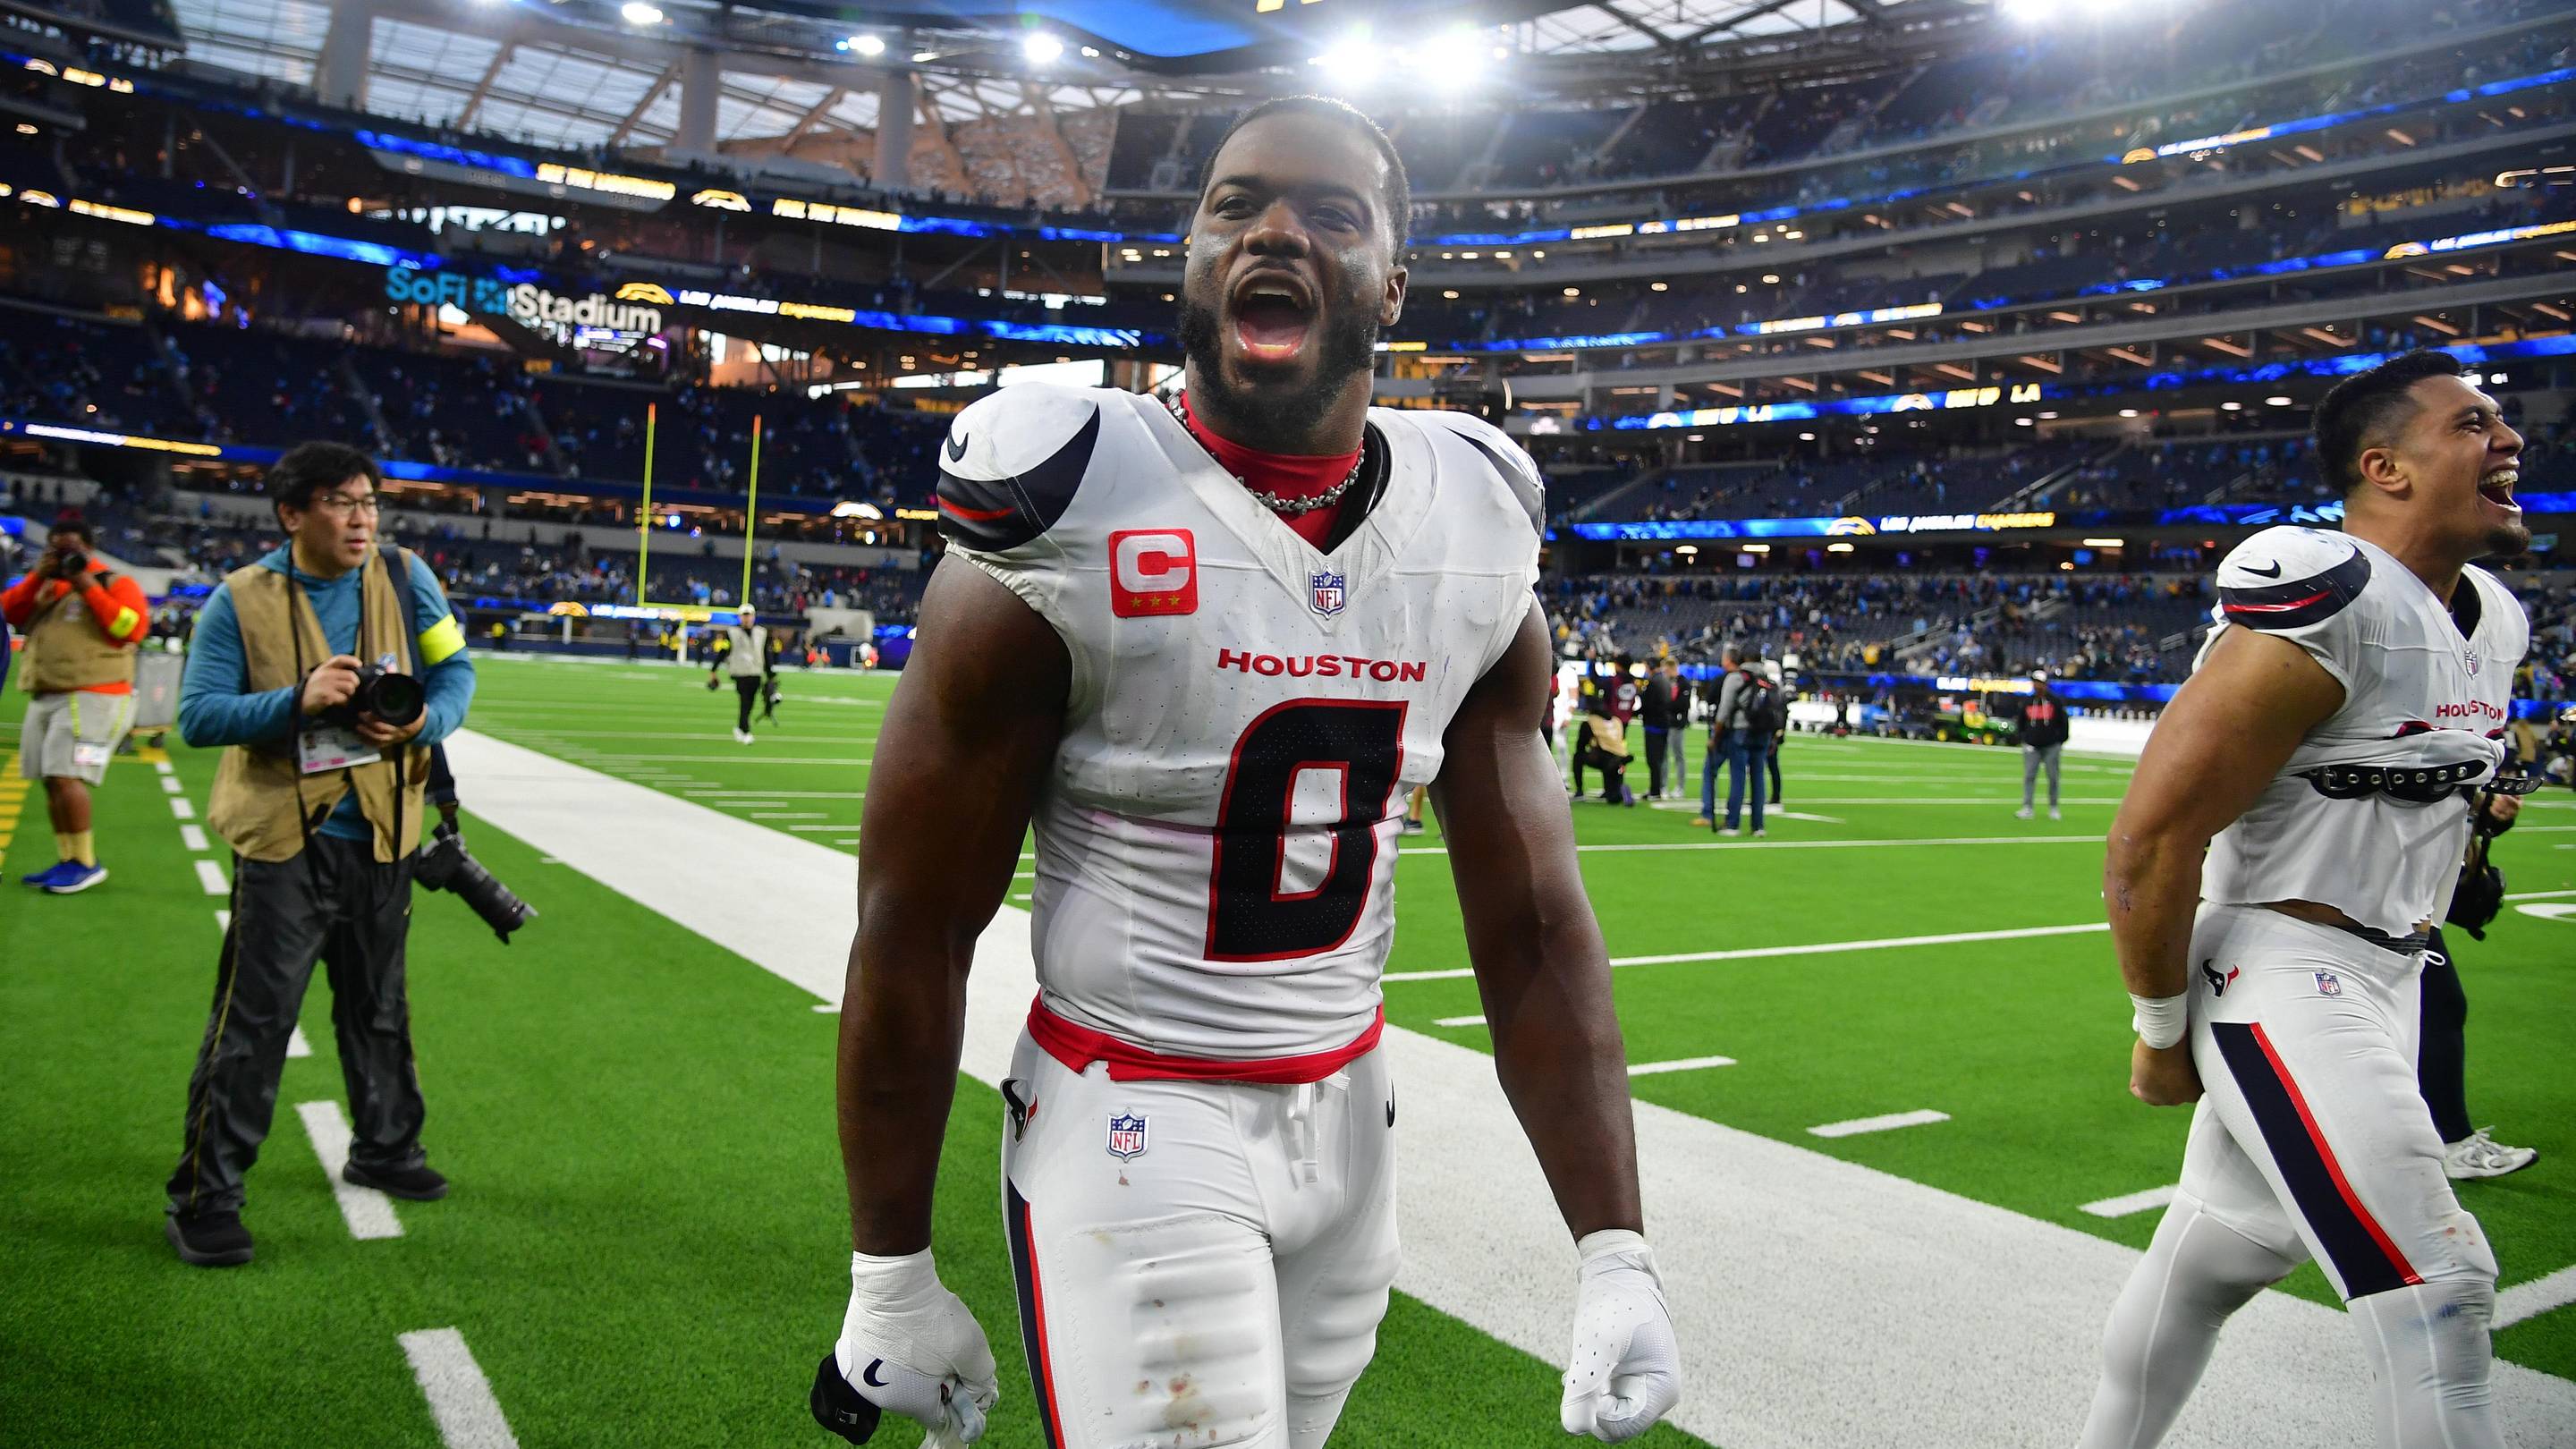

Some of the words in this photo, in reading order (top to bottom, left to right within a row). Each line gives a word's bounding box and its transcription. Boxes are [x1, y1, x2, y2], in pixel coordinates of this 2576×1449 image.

[386, 265, 467, 309] SoFi
[513, 283, 661, 334] Stadium
[1117, 534, 1190, 592] C
[1315, 589, 1342, 609] NFL
[1217, 648, 1427, 682] HOUSTON
[2436, 699, 2504, 720] HOUSTON
[1204, 698, 1409, 963] 0
[1113, 1131, 1140, 1151] NFL
